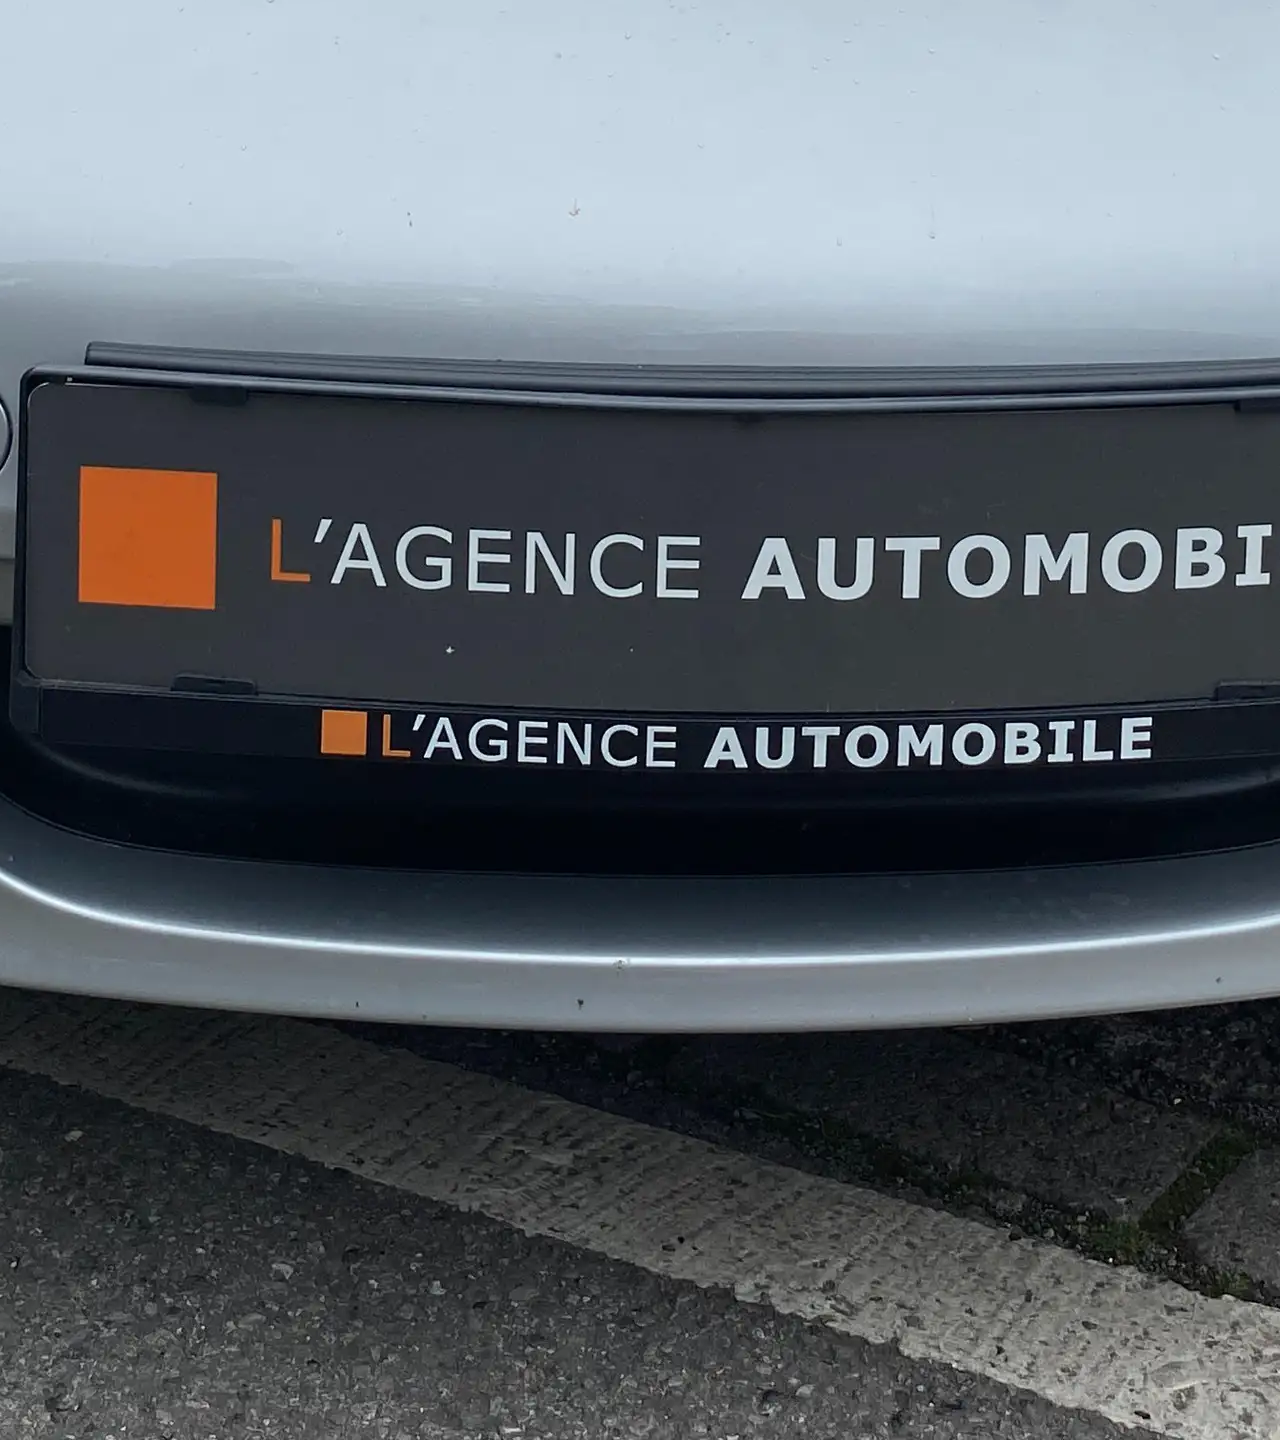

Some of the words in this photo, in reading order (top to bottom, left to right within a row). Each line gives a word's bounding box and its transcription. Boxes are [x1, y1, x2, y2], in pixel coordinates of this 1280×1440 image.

[269, 518, 700, 600] L'AGENCE
[380, 713, 677, 769] L'AGENCE
[703, 716, 1153, 770] AUTOMOBILE
